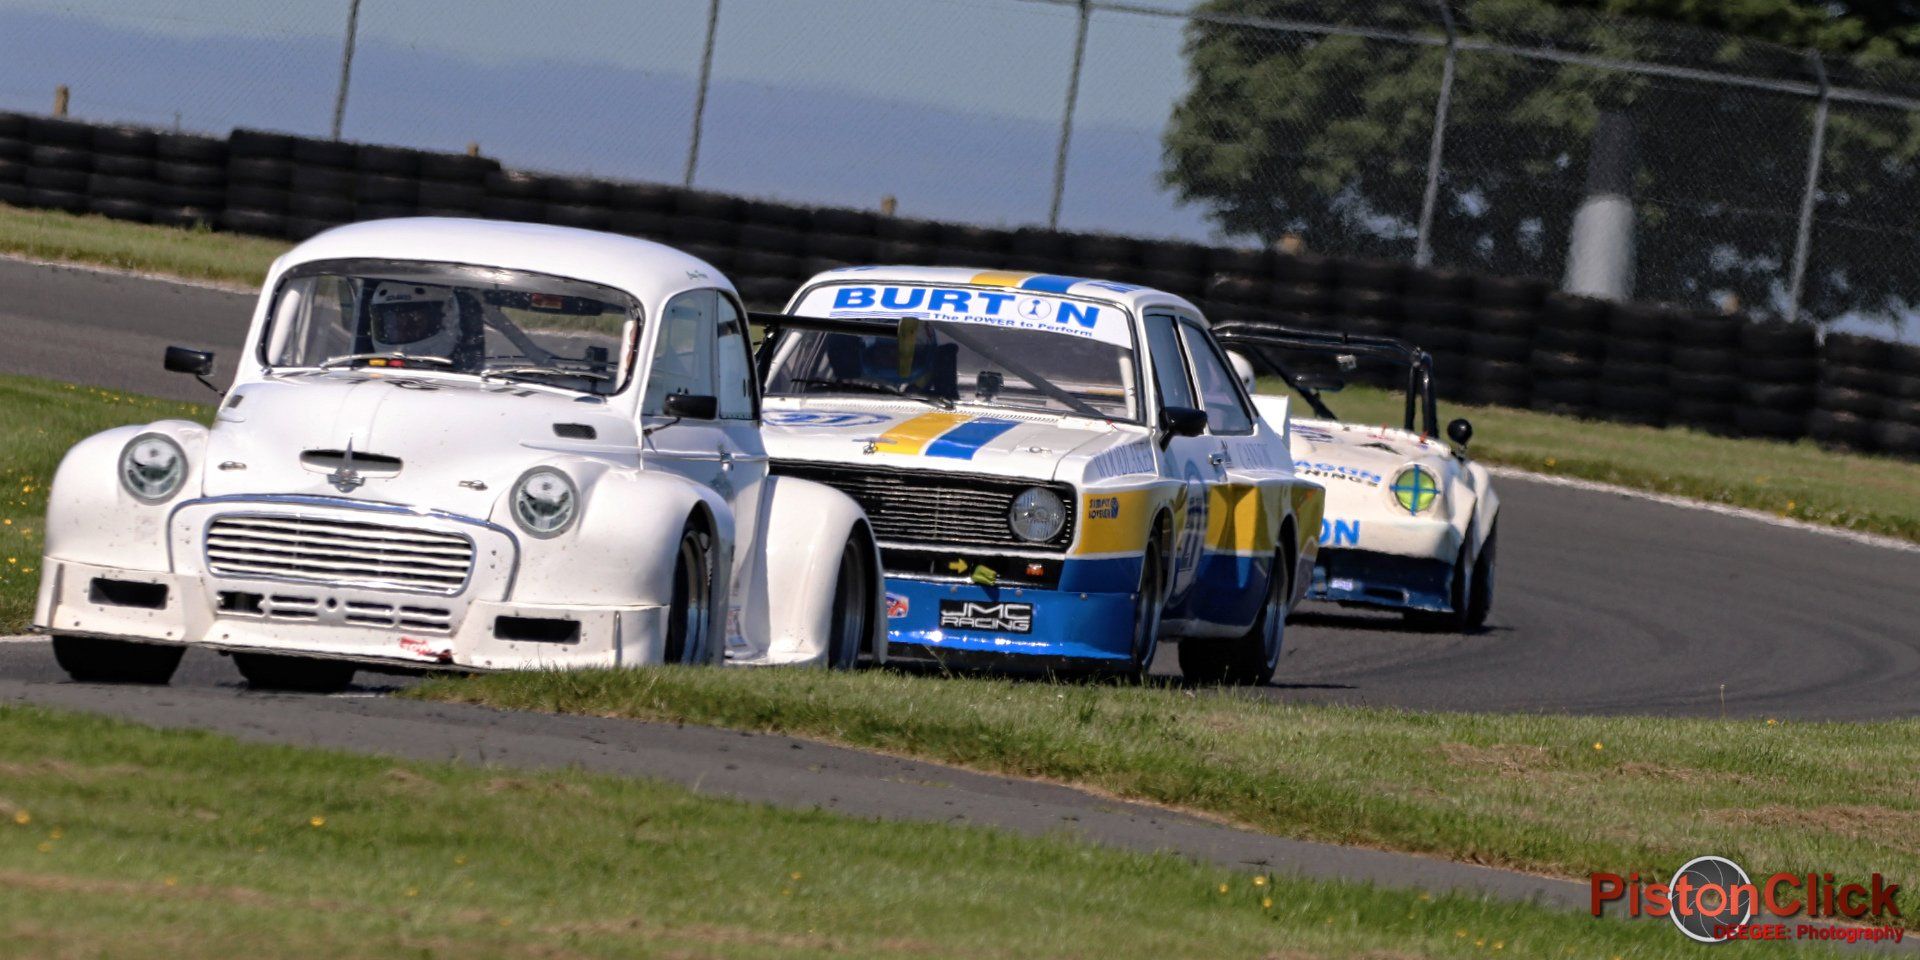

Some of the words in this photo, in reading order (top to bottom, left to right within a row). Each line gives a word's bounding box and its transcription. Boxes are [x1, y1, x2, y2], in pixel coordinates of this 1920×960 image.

[934, 313, 954, 321] The
[964, 315, 1015, 327] POWER
[1038, 323, 1093, 337] Perform
[941, 603, 1031, 620] JMC
[940, 616, 1030, 632] RACING
